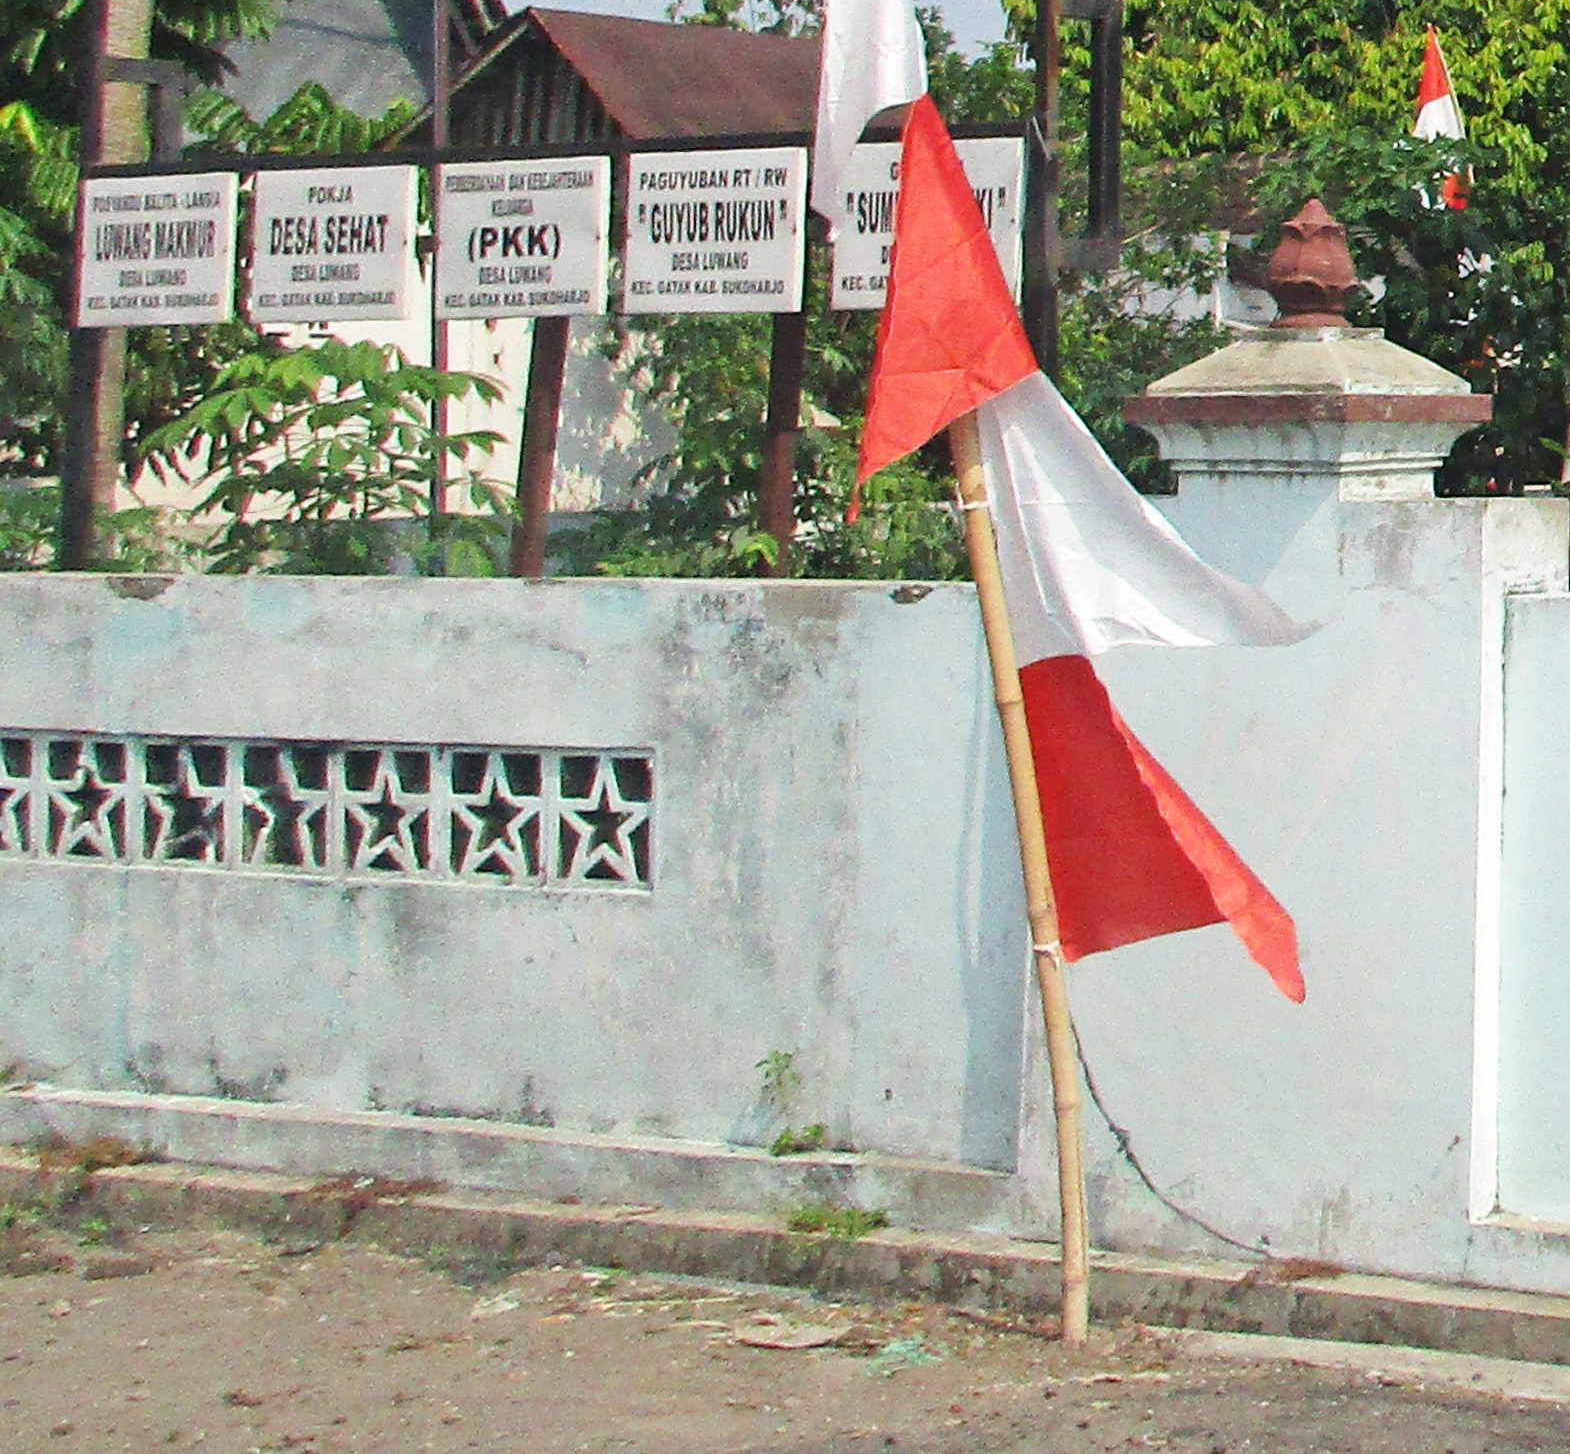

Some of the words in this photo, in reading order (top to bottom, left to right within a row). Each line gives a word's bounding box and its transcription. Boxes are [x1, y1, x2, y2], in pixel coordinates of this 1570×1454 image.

[639, 169, 728, 191] PAGUYUBAN
[733, 168, 752, 188] RT
[764, 167, 788, 187] RW
[308, 185, 353, 204] POKJA
[270, 216, 318, 255] DESA
[324, 213, 389, 254] SEHAT
[468, 223, 562, 263] (PKK)
[671, 251, 699, 271] DESA
[703, 251, 749, 270] LUWANG
[479, 266, 505, 285] DESA
[657, 281, 691, 294] GATAK
[721, 279, 785, 295] SUKOHARJO
